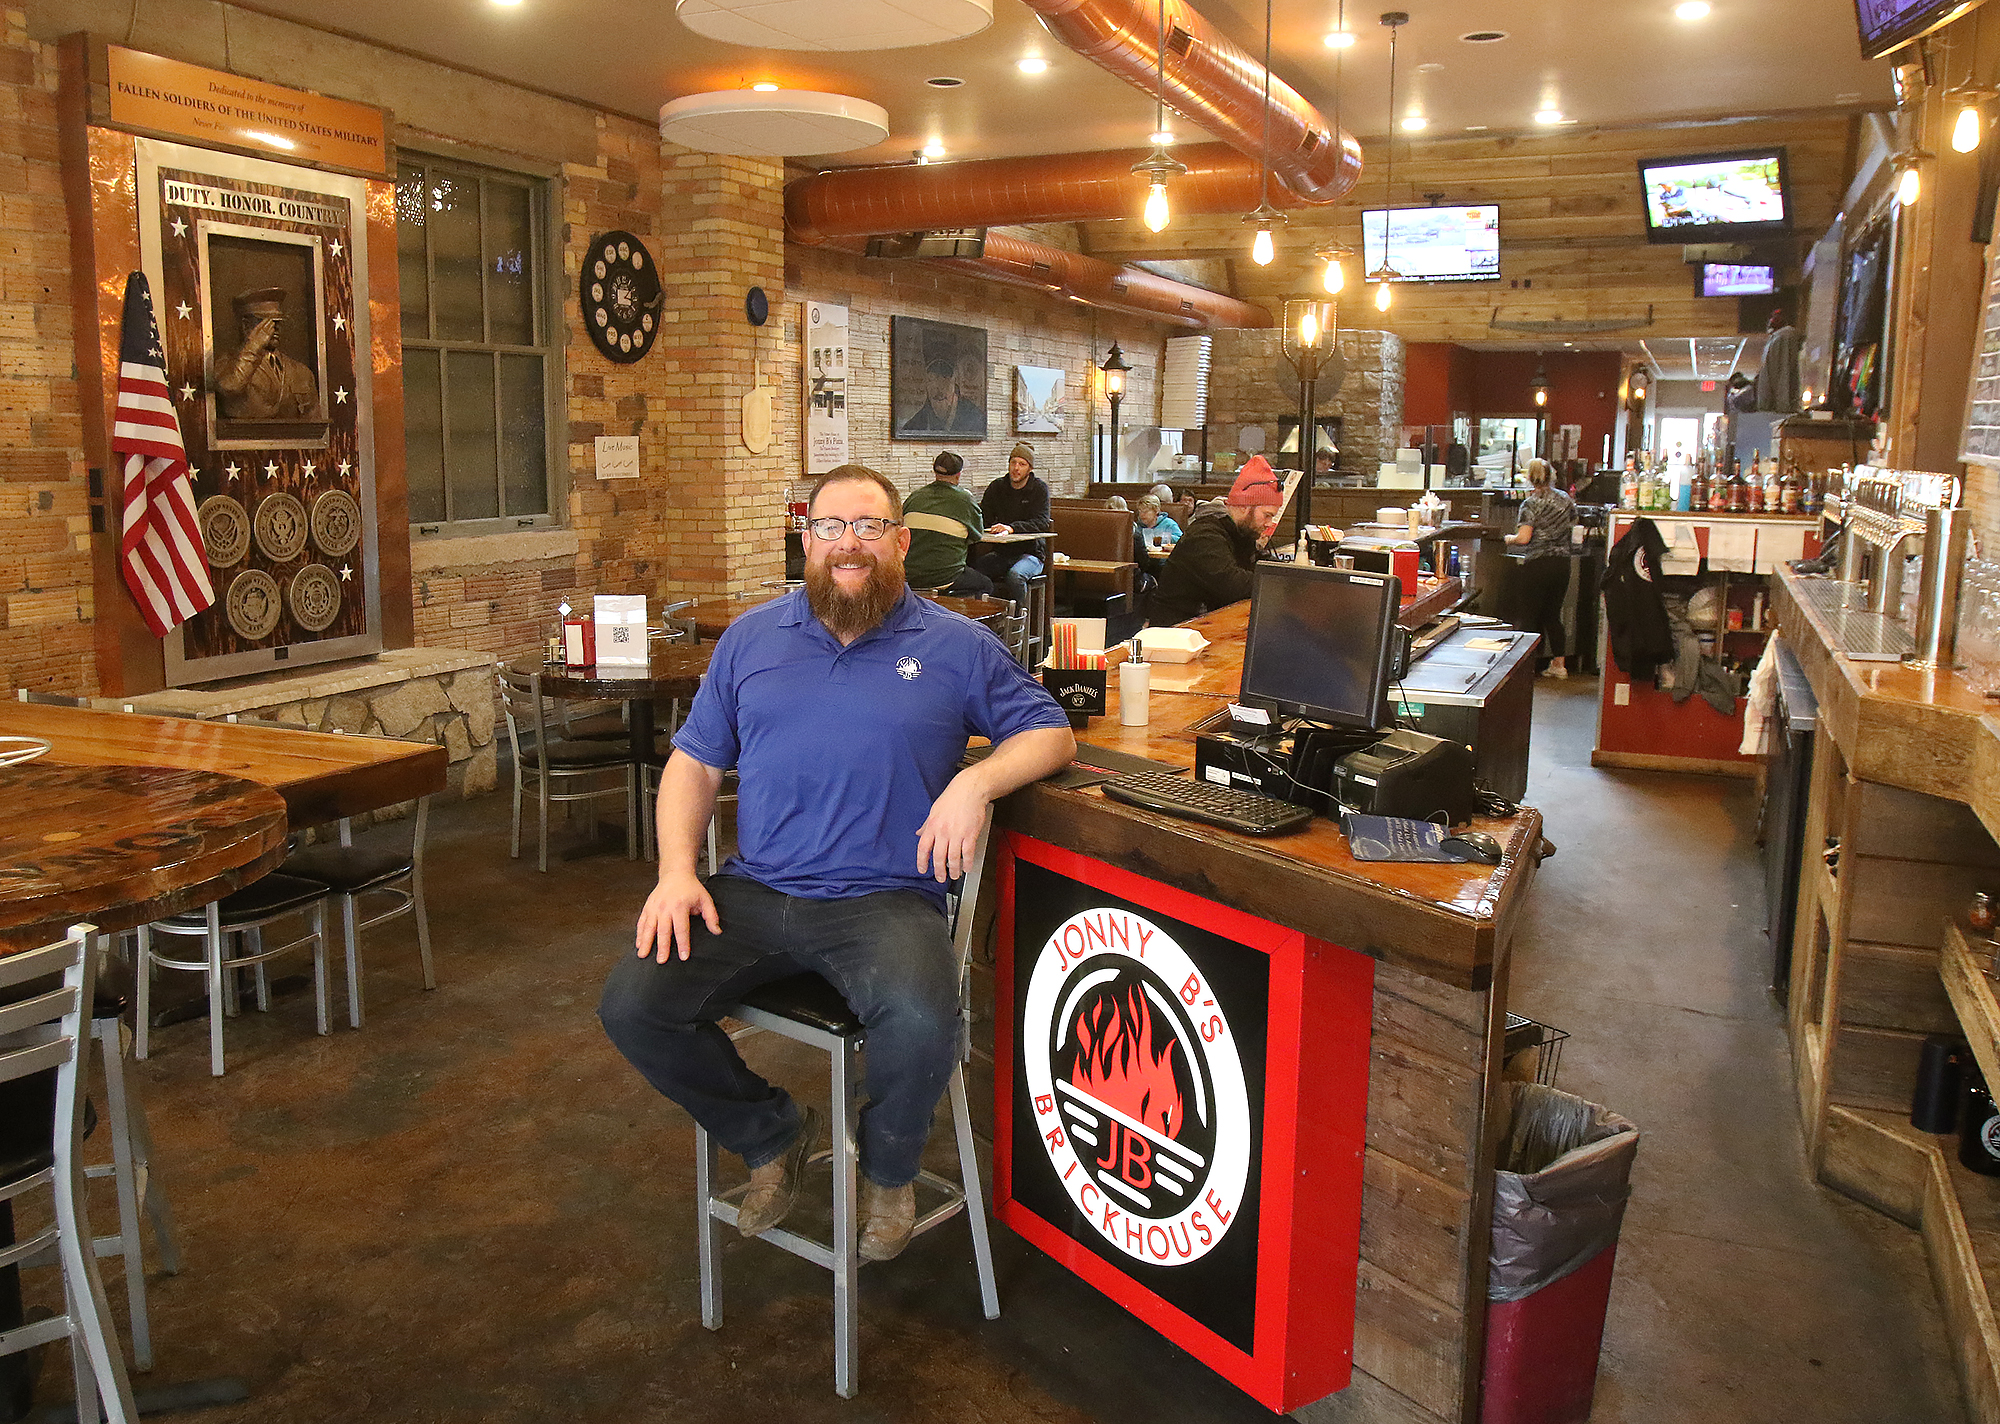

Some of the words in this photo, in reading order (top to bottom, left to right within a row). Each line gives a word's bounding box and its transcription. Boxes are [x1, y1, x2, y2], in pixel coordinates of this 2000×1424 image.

[117, 81, 160, 100] FALLEN
[163, 92, 216, 113] SOLDIERS
[218, 104, 231, 116] OF
[235, 107, 255, 120] THE
[258, 112, 297, 130] UNITED
[299, 121, 332, 137] STATES
[334, 128, 379, 147] MILITARY
[208, 81, 246, 100] Dedicated
[255, 95, 267, 105] the
[267, 99, 296, 114] memory
[168, 184, 215, 206] DUTY.
[220, 192, 276, 215] HONOR.
[1059, 685, 1074, 698] JACK
[1074, 683, 1099, 699] DANIEL'S
[1053, 912, 1154, 973] JONNY
[1178, 971, 1225, 1044] B'S
[1034, 1093, 1233, 1261] BRICKHOUSE
[1096, 1119, 1153, 1190] JB
